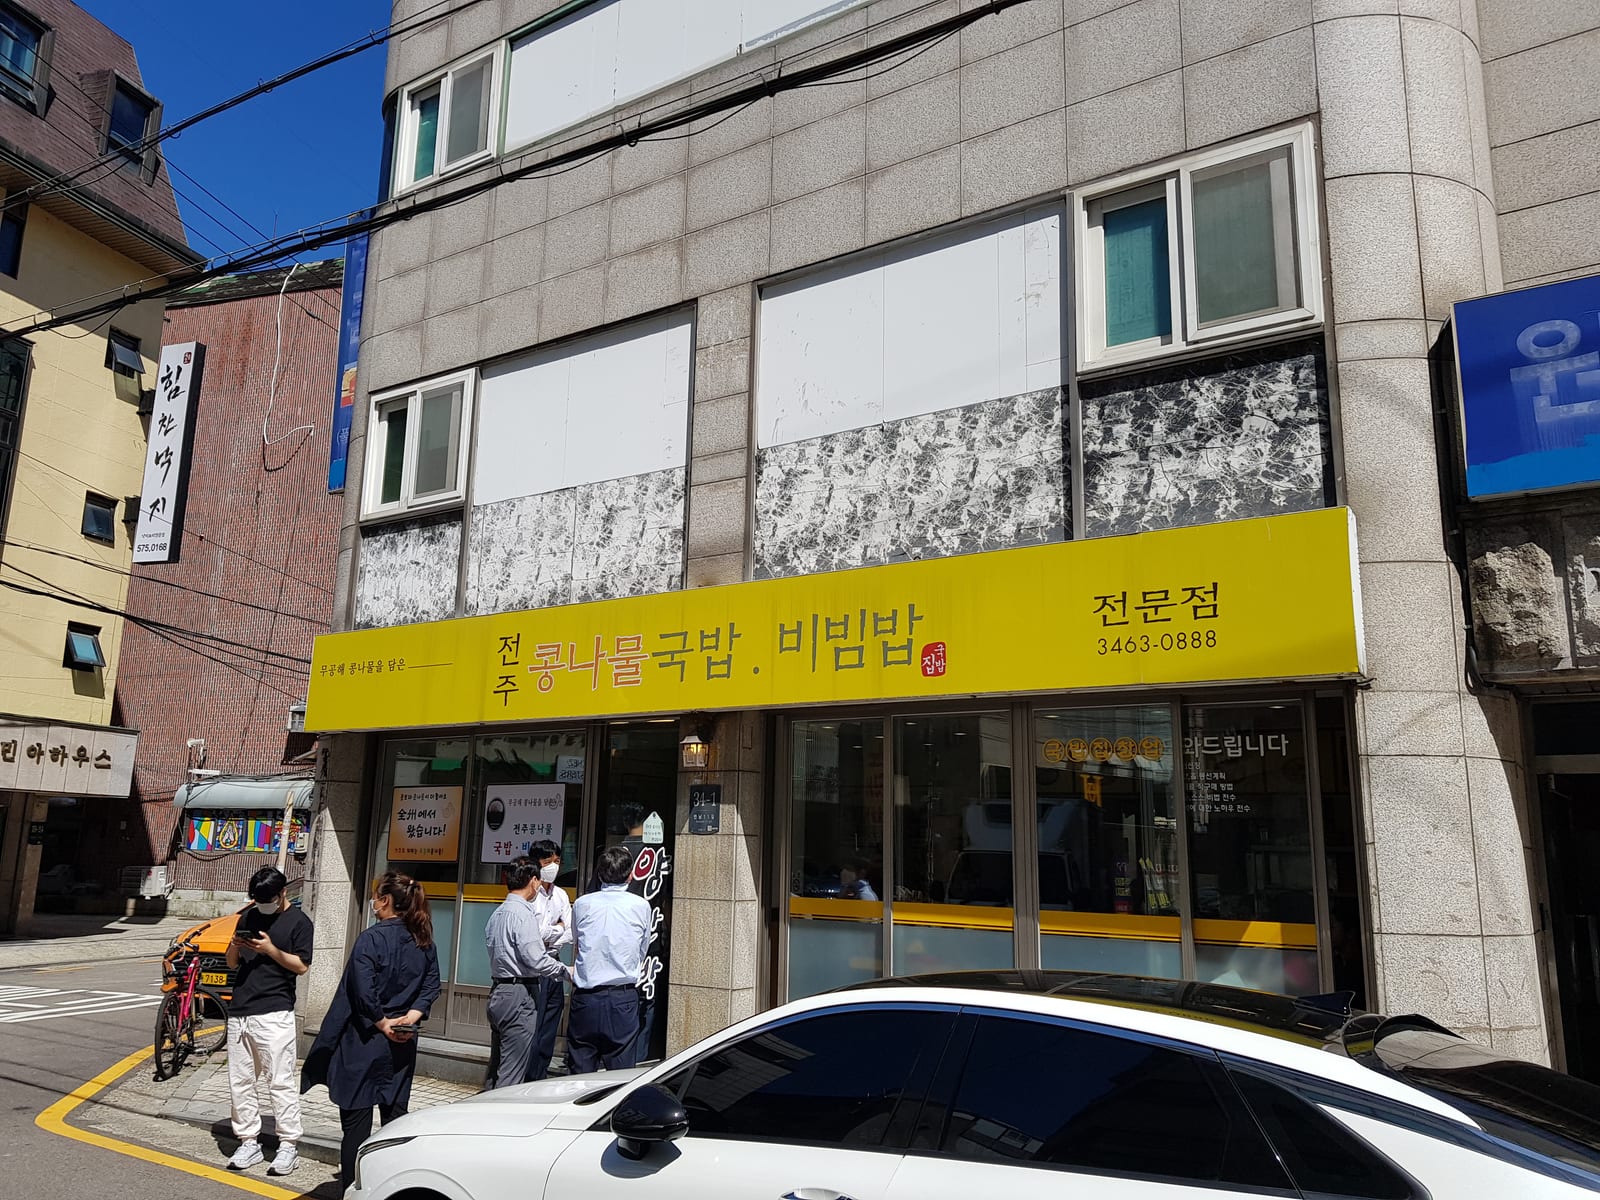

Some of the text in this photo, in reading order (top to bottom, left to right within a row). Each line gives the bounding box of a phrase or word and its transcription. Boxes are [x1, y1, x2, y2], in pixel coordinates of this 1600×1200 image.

[1093, 582, 1219, 627] 전문점
[778, 603, 925, 673] 비빔밥
[1097, 630, 1217, 655] 3463-0888
[319, 657, 406, 677] 무공해 콩나물을 담은
[492, 632, 521, 707] 전주
[1184, 734, 1289, 758] 와드립니다
[693, 791, 717, 807] 34-1
[406, 823, 448, 838] 왔습니다!
[512, 823, 553, 836] 전주콩나물
[493, 840, 513, 856] 국밥
